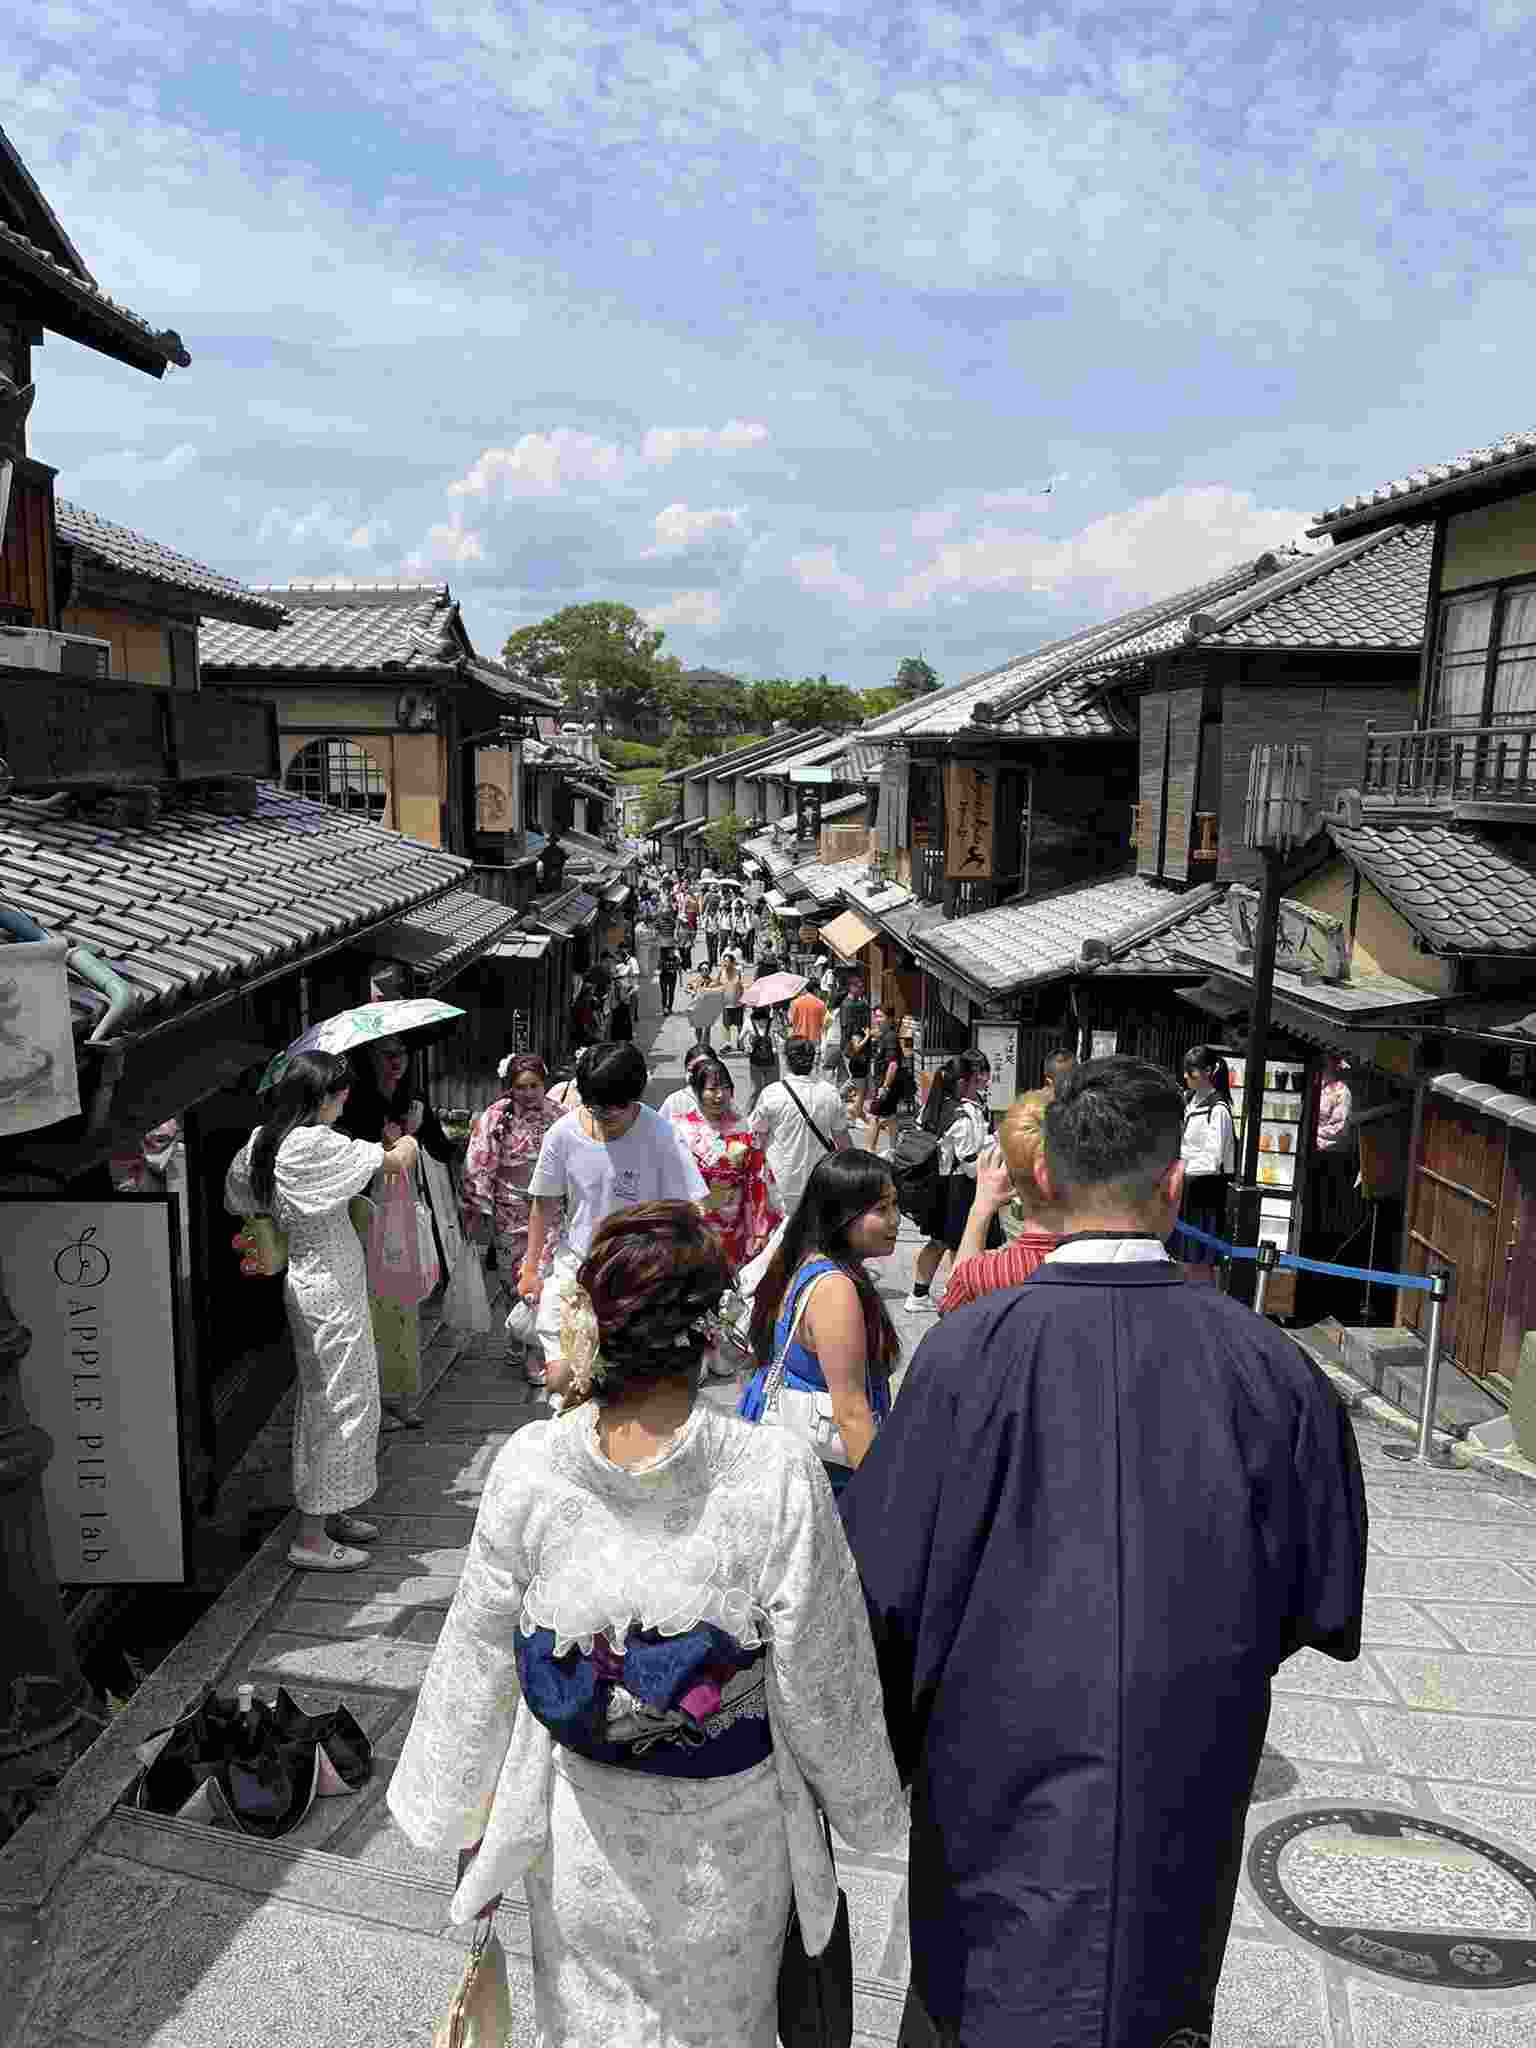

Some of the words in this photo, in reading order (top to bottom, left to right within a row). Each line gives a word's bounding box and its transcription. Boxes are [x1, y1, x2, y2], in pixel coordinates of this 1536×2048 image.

[67, 1299, 103, 1411] APPLE
[77, 1434, 109, 1489] PIE
[80, 1511, 109, 1564] lab
